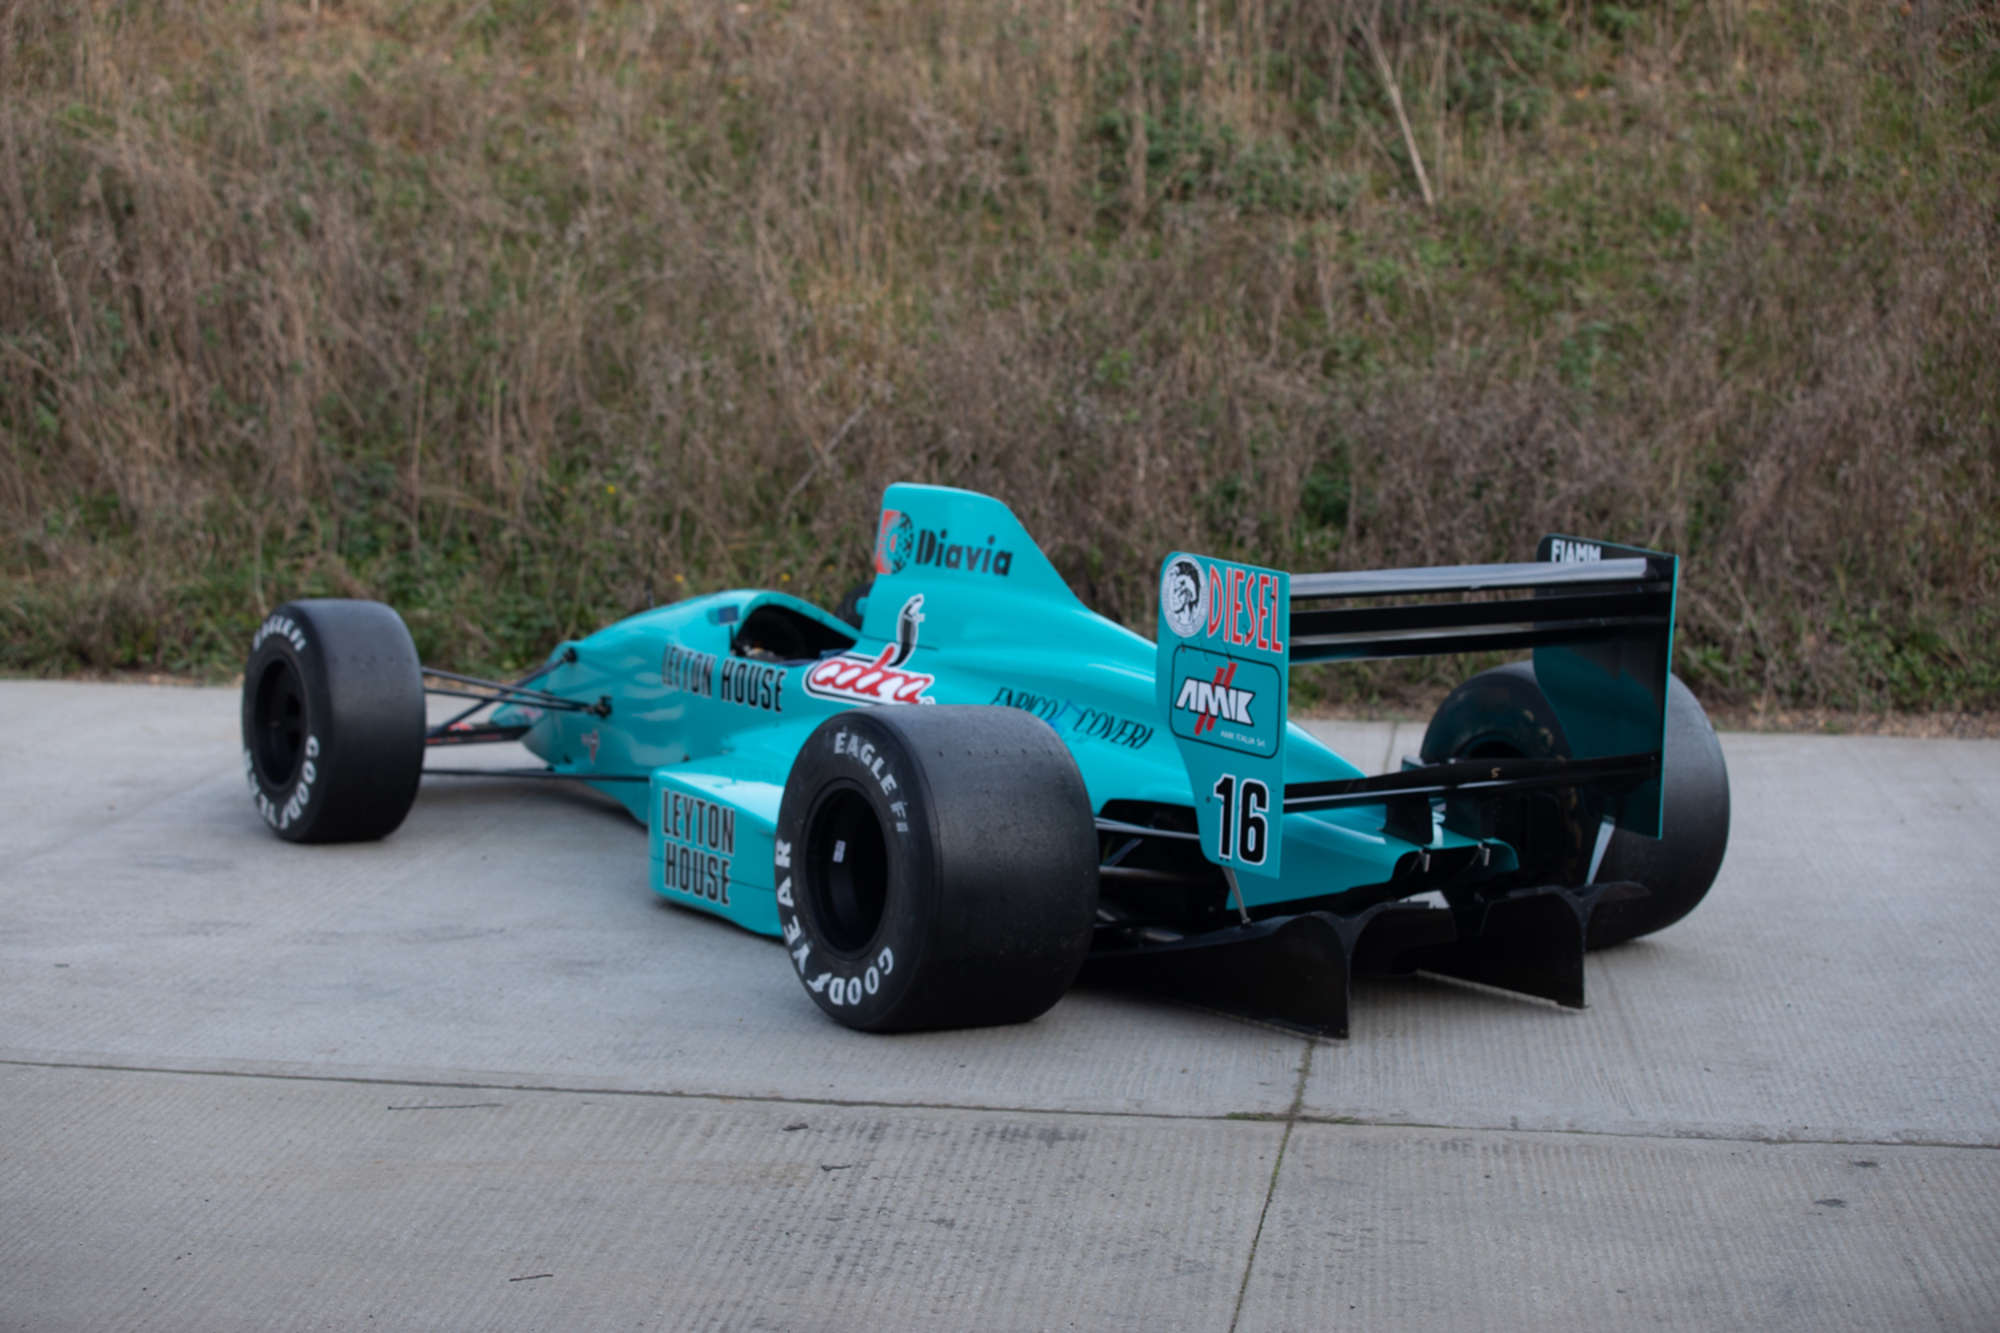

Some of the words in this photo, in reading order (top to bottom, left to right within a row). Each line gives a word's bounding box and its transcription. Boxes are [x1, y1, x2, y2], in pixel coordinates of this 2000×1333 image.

[916, 530, 1013, 576] Diavia
[1551, 539, 1602, 562] FIAMM
[1207, 564, 1283, 654] DIESEL
[662, 643, 717, 698] LEYTON
[721, 658, 787, 713] HOUSE
[1175, 677, 1256, 727] AMK
[1073, 707, 1155, 750] COVERI
[834, 732, 897, 796] EAGLE
[661, 788, 735, 857] LEYTON
[1213, 773, 1270, 866] 16
[665, 840, 732, 908] HOUSE
[775, 839, 894, 1006] GOODYEAR
